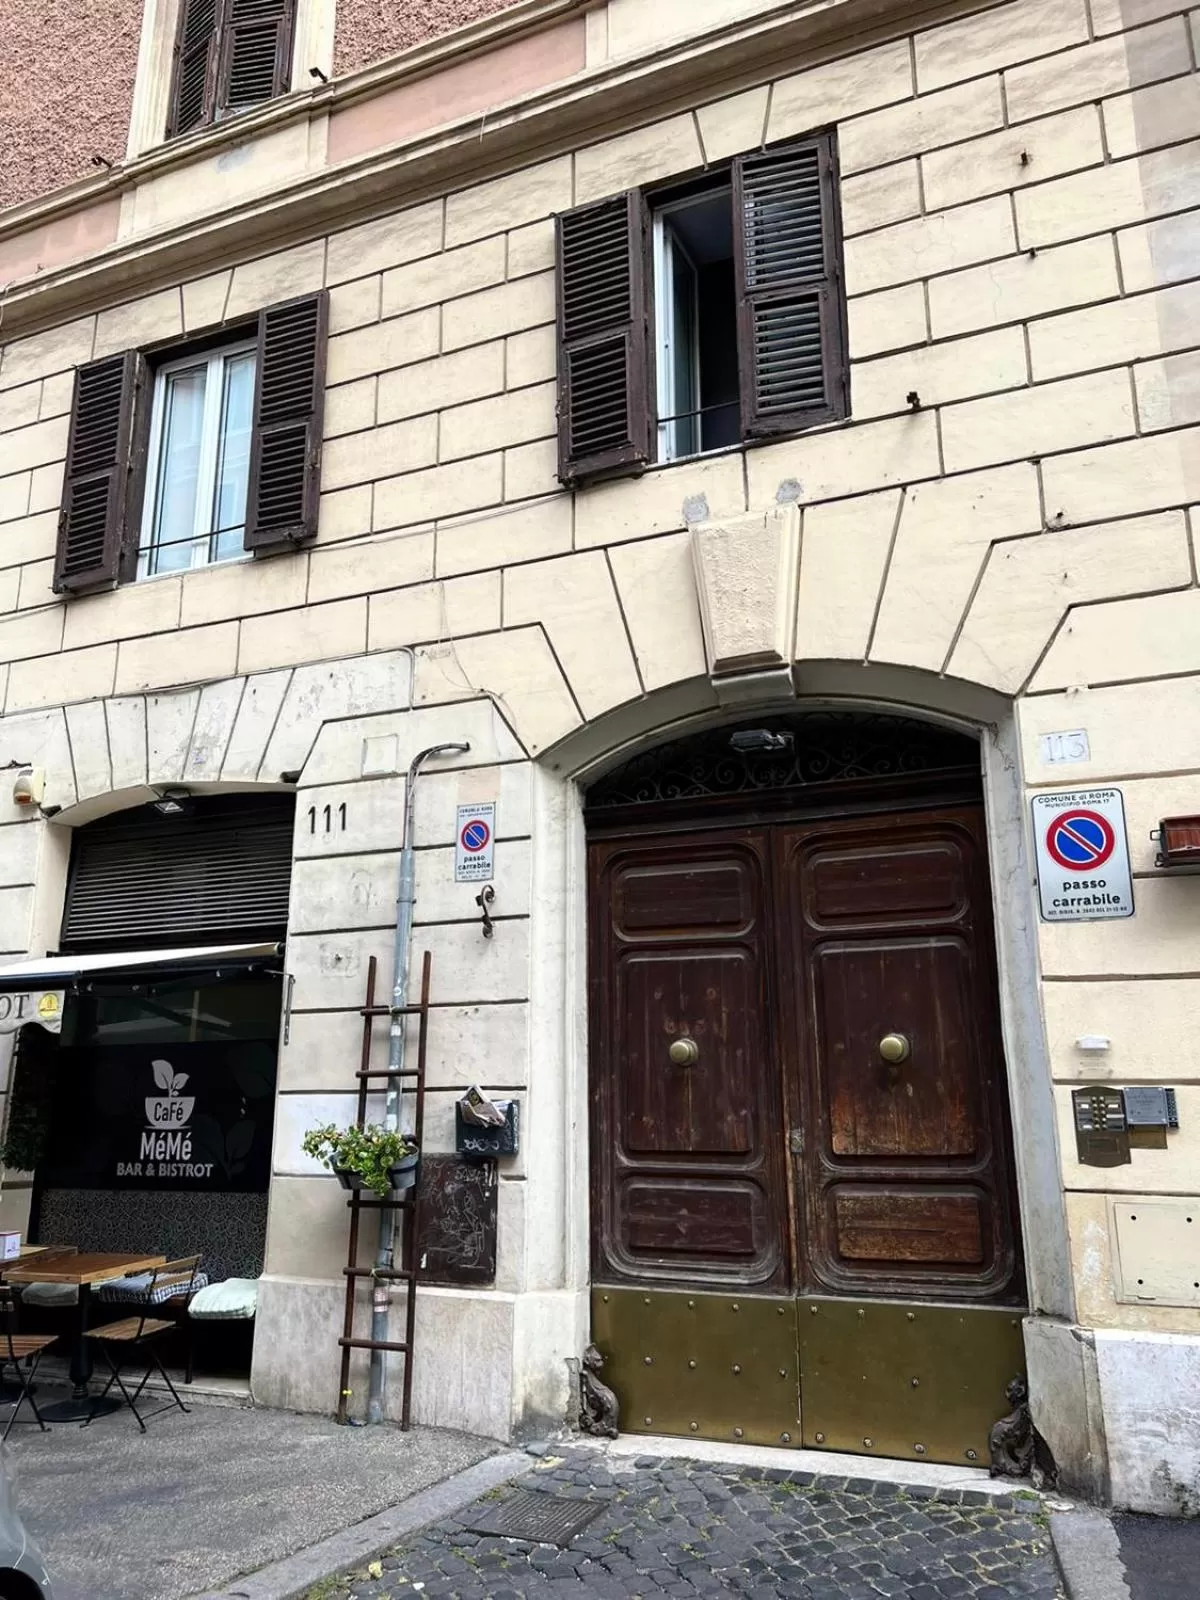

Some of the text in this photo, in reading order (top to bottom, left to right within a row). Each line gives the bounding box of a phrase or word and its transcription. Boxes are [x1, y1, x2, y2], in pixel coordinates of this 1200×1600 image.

[1038, 794, 1077, 804] COMUNE
[1089, 791, 1116, 800] ROMA
[1045, 800, 1081, 808] MUNICIPIO
[308, 802, 347, 835] 111
[458, 861, 491, 871] carrabile
[463, 855, 486, 864] passo
[1062, 879, 1107, 892] passo
[1052, 893, 1121, 907] carrabile
[116, 1162, 214, 1178] BAR & BISTROT
